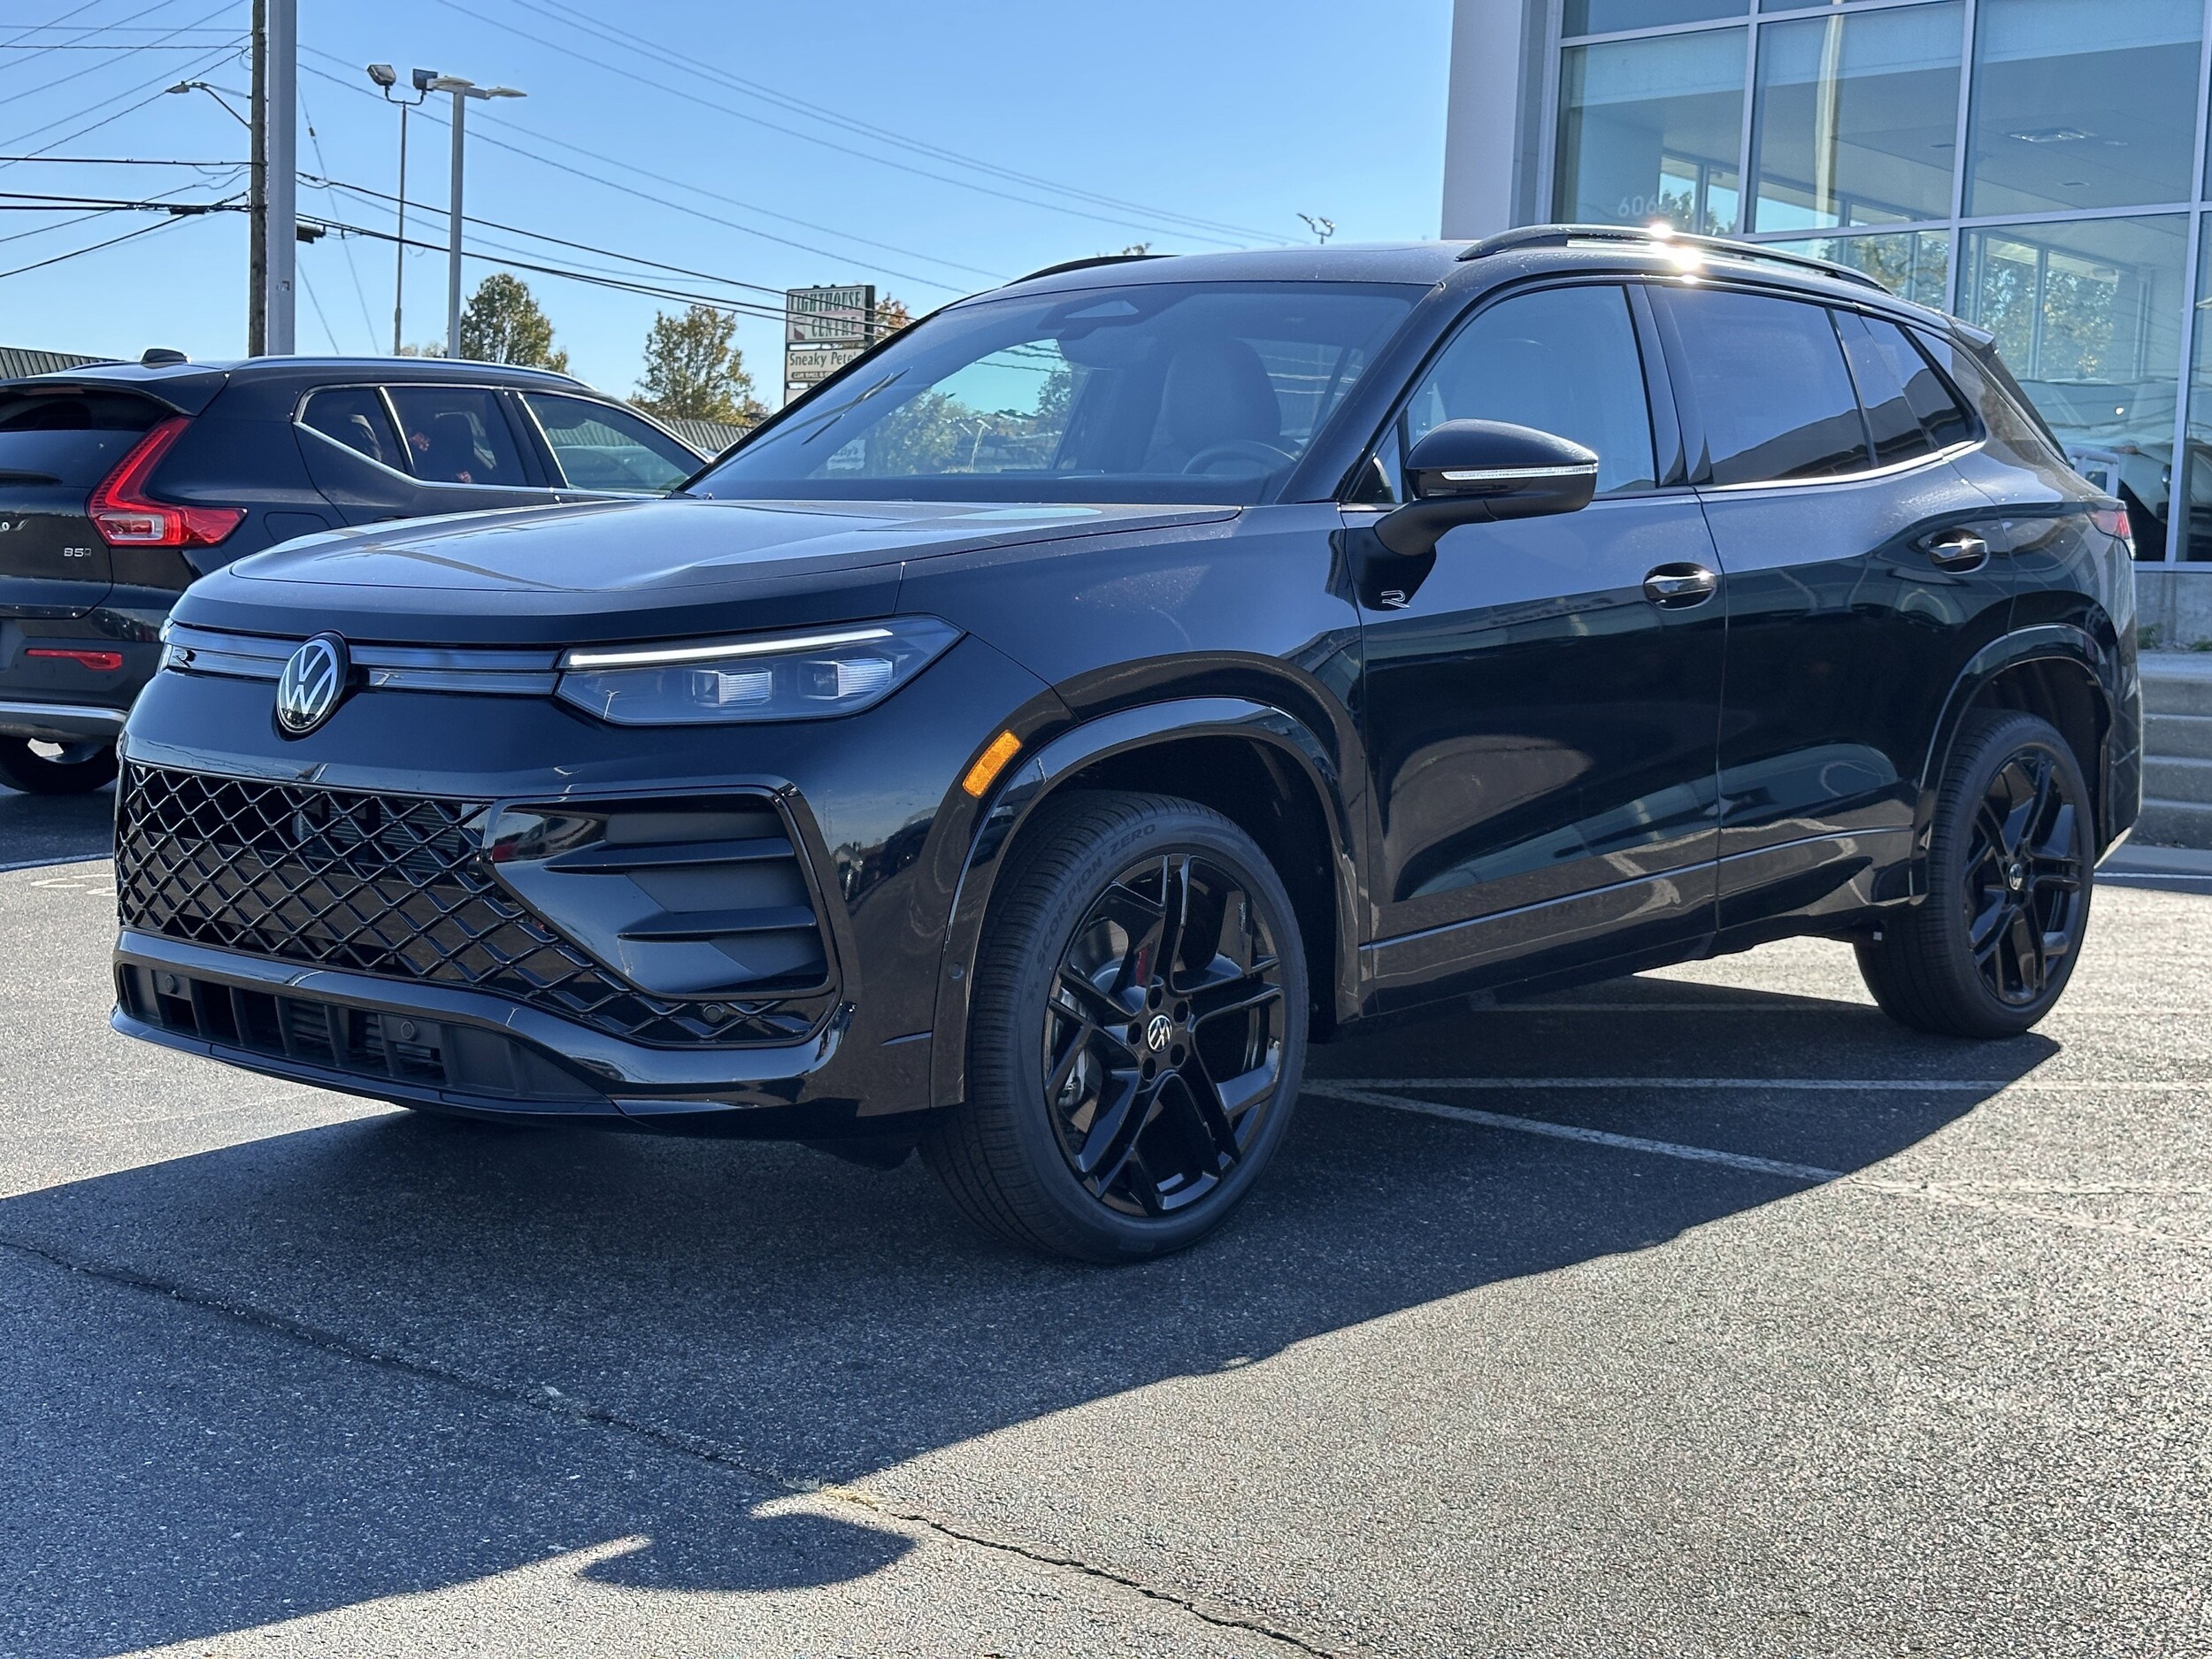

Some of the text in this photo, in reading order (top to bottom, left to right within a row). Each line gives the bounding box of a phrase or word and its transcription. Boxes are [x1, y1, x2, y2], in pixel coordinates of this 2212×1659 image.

[789, 352, 827, 368] Sneaky
[1381, 590, 1409, 608] R
[1036, 856, 1102, 970] SCORPION
[1109, 823, 1156, 856] ZERO
